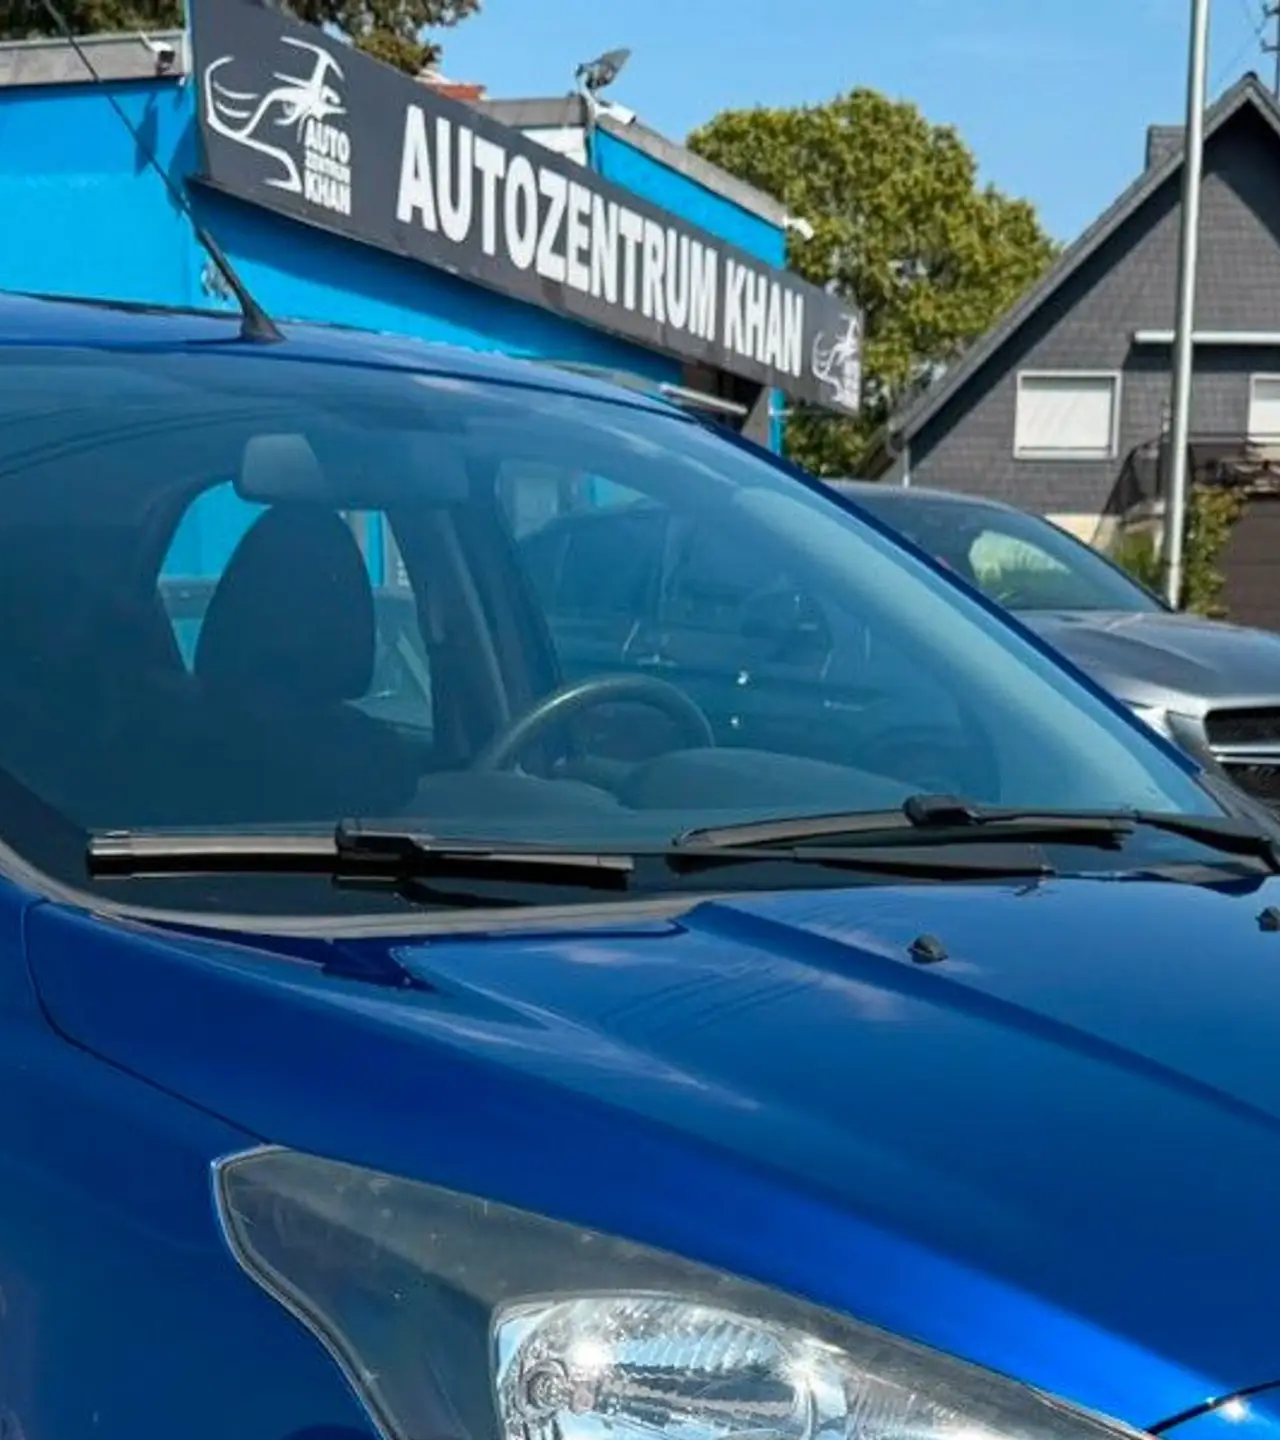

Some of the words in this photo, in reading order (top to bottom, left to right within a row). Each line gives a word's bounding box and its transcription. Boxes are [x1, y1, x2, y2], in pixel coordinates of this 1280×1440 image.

[305, 118, 351, 164] AUTO
[304, 168, 352, 216] KHAN
[396, 104, 718, 342] AUTOZENTRUM
[723, 258, 804, 378] KHAN
